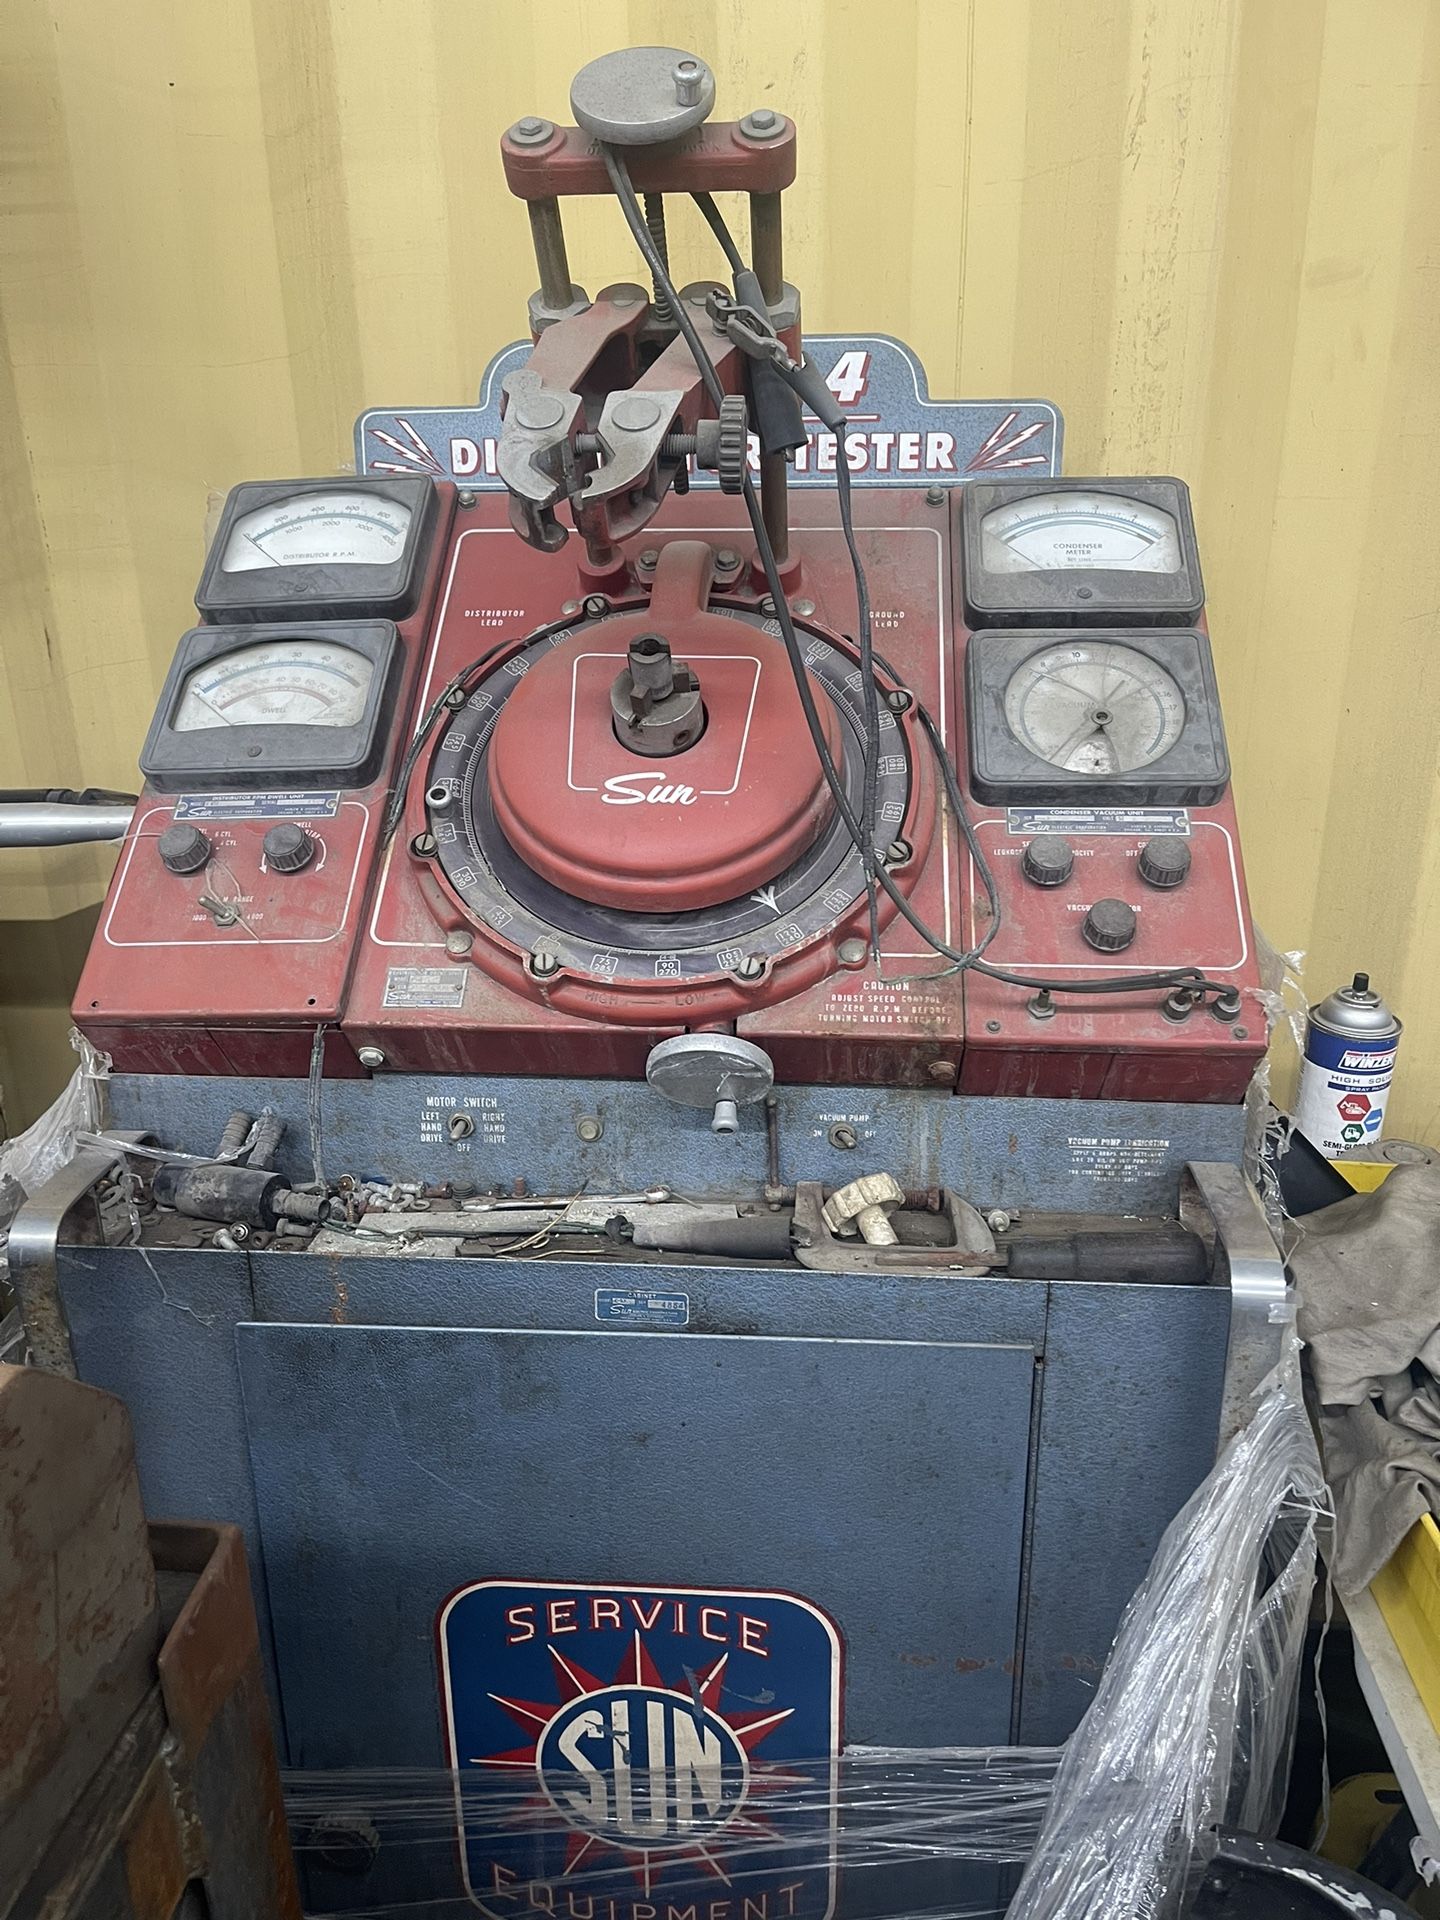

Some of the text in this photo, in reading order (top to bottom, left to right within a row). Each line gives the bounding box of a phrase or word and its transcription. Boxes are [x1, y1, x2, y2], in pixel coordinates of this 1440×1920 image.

[825, 351, 870, 404] 4
[795, 433, 954, 471] TESTER
[283, 552, 330, 560] DISTRIBUTOR
[869, 611, 905, 619] GROUND
[480, 619, 504, 627] LEAD
[601, 771, 698, 805] Sun
[1023, 821, 1050, 831] Sun
[461, 871, 472, 883] 30
[721, 951, 739, 961] 105
[599, 957, 611, 966] 75
[863, 981, 910, 991] CAUTION
[585, 992, 619, 1005] HIGH
[674, 992, 706, 1006] LOW
[831, 994, 863, 1003] ADJUST
[868, 995, 896, 1004] SPEED
[825, 1004, 835, 1012] TO
[843, 1004, 865, 1012] ZERO
[862, 1015, 892, 1023] MOTOR
[1331, 1074, 1360, 1084] HIGH
[427, 1097, 498, 1108] MOTOR SWITCH
[421, 1112, 440, 1120] LEFT
[482, 1113, 505, 1122] RIGHT
[819, 1114, 847, 1122] VACUUM
[420, 1123, 442, 1131] HAND
[484, 1124, 505, 1133] HAND
[420, 1134, 443, 1143] DRIVE
[483, 1135, 506, 1144] DRIVE
[457, 1143, 471, 1152] OFF
[610, 1304, 632, 1315] Sun
[506, 1598, 770, 1658] SERVICE
[558, 1699, 723, 1838] SUN
[492, 1862, 804, 1920] EQUIPMENT
